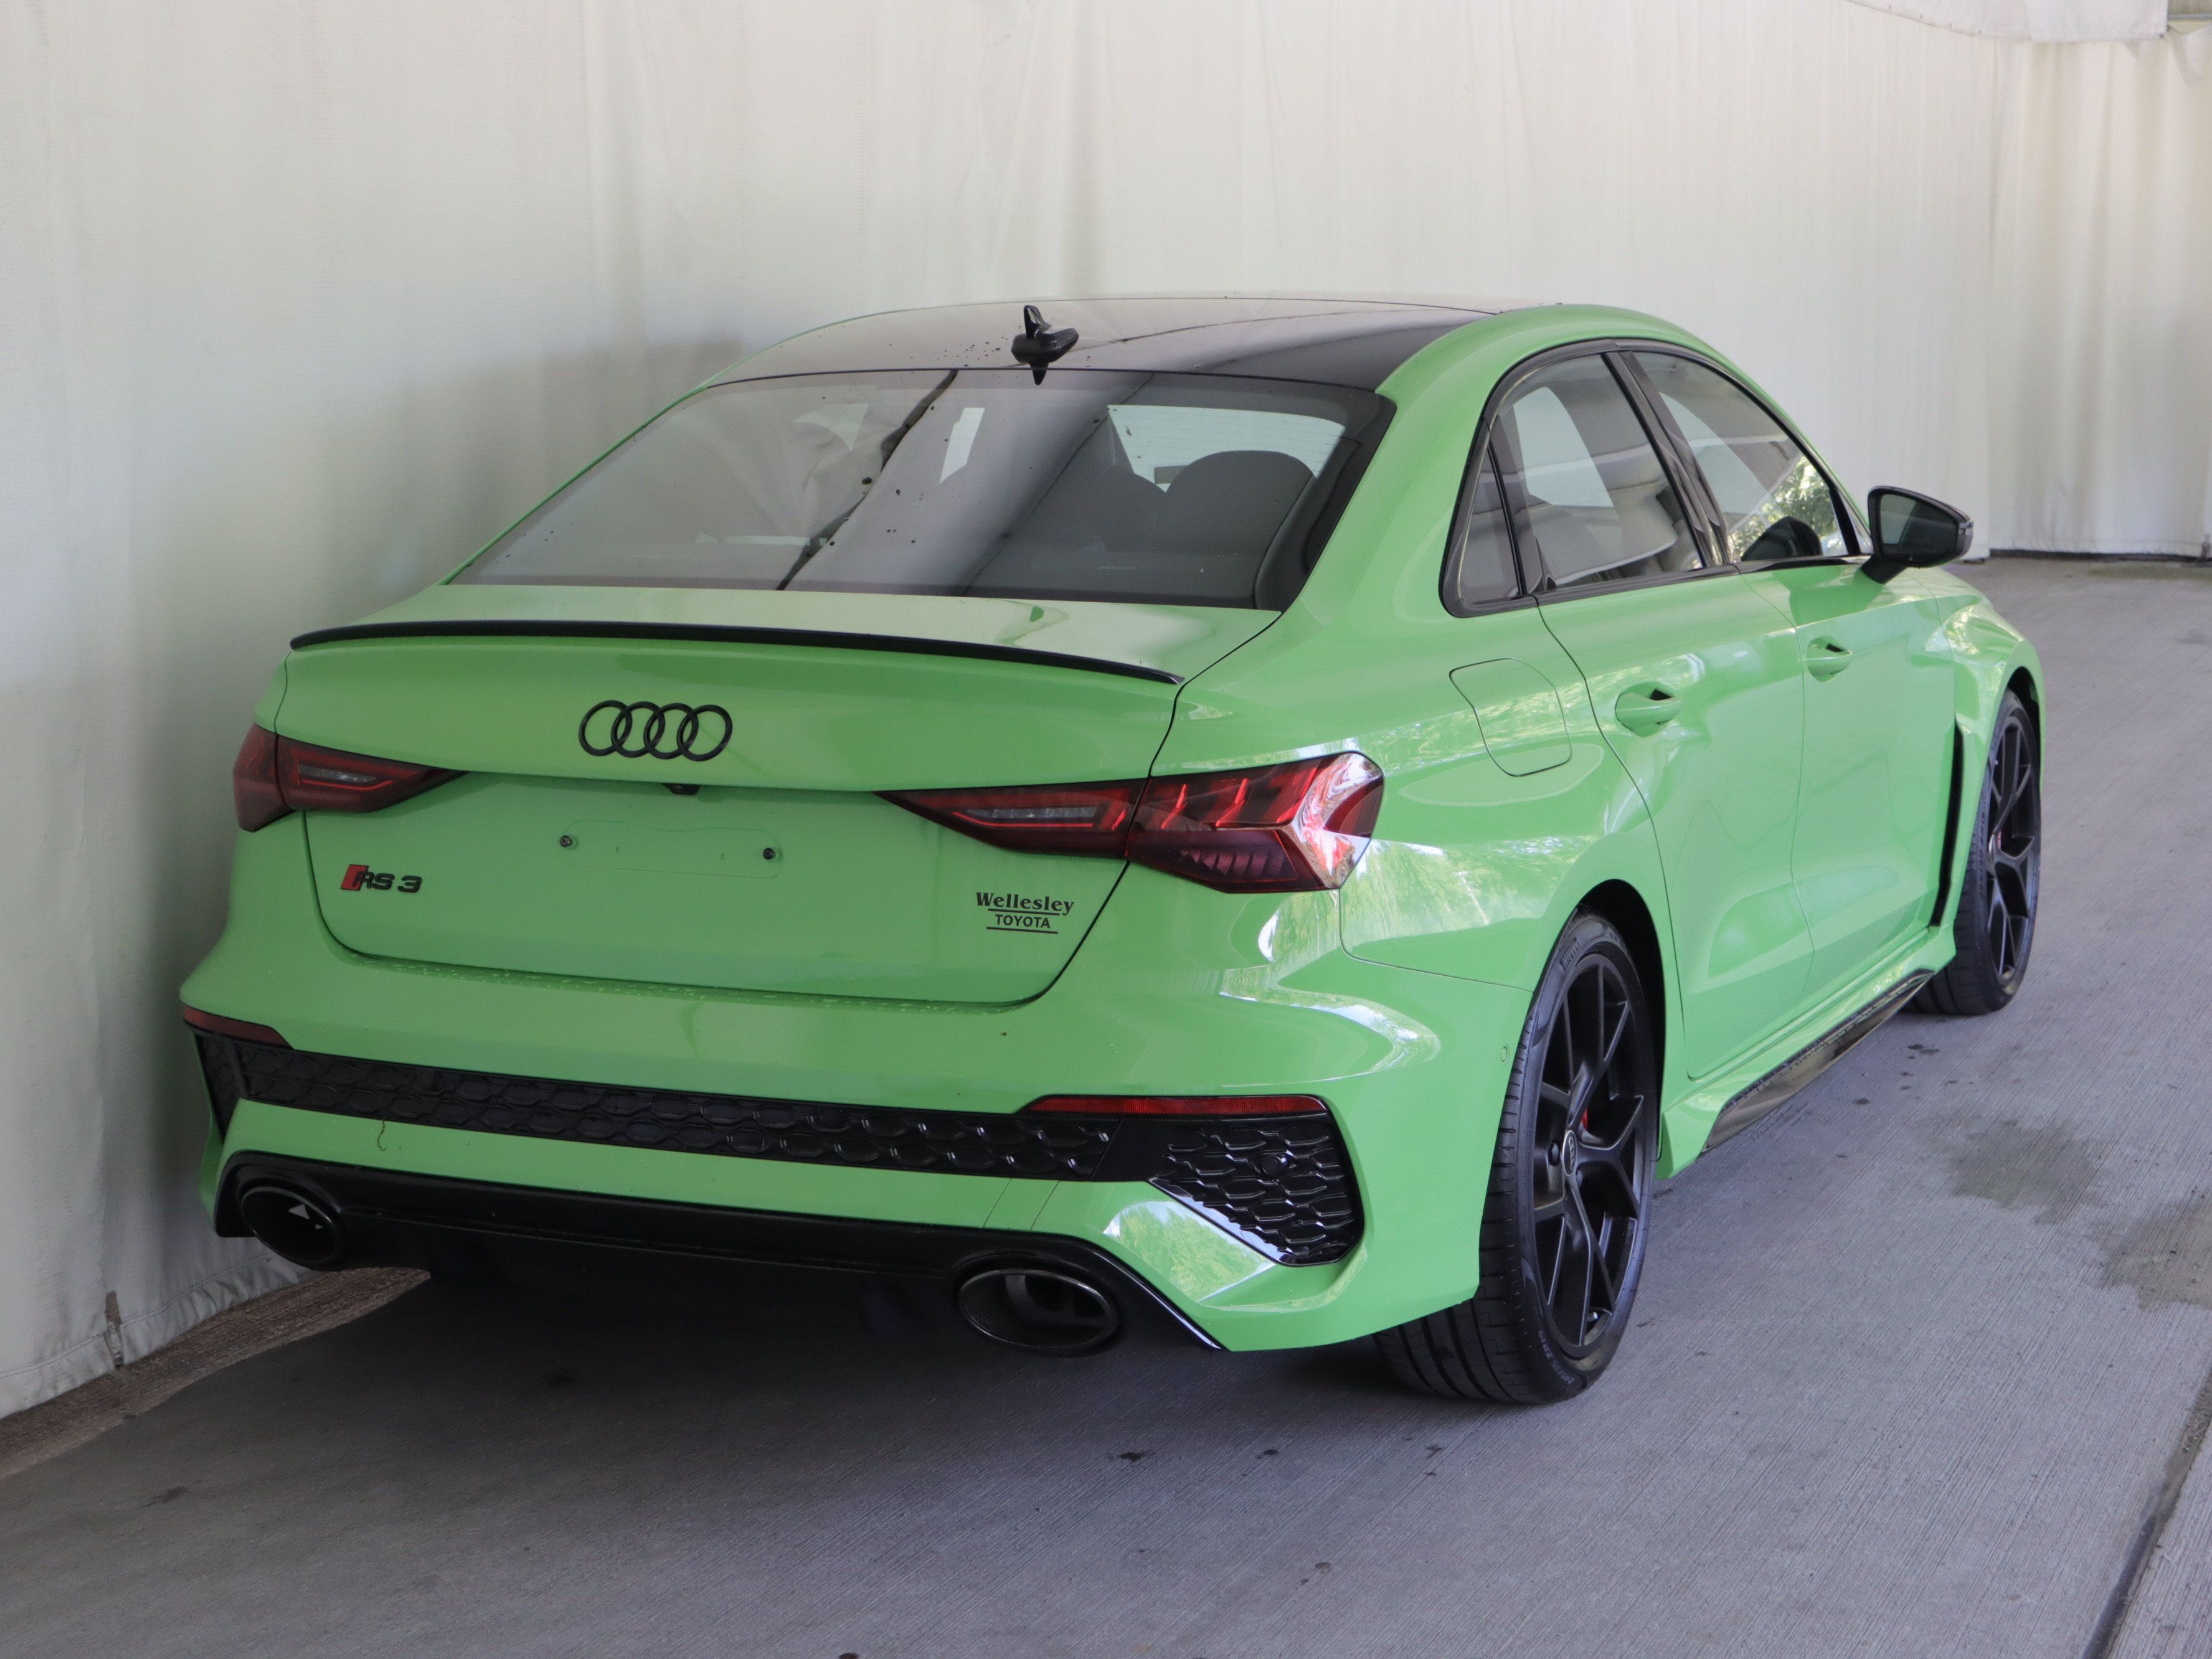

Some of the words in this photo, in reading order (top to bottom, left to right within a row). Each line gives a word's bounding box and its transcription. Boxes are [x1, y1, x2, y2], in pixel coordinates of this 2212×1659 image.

[351, 871, 395, 891] RS
[397, 875, 423, 893] 3
[976, 892, 1075, 915] Wellesley
[995, 914, 1051, 929] TOYOTA
[1559, 937, 1581, 971] PIRELLI
